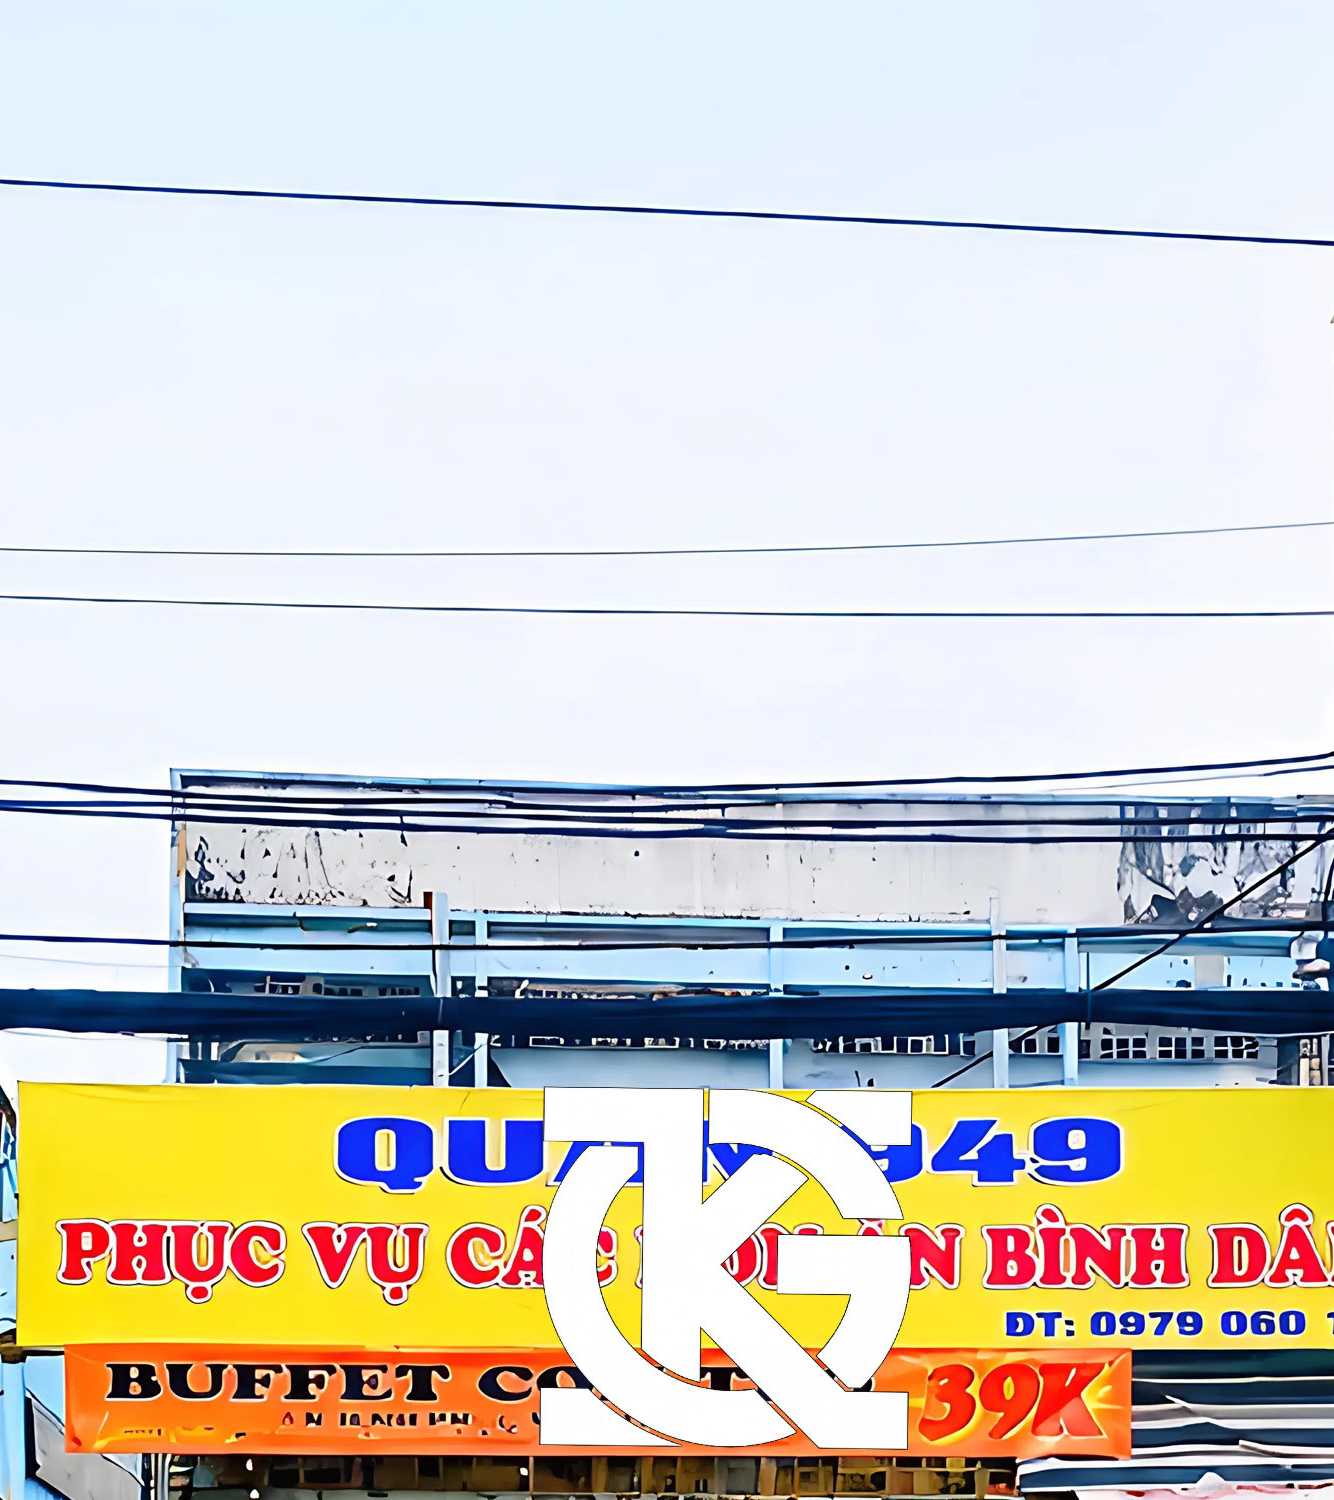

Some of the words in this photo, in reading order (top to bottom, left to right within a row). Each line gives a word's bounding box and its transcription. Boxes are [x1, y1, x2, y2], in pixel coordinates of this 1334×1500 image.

[56, 1218, 286, 1304] PHỤC
[302, 1221, 430, 1305] VỤ
[981, 1202, 1190, 1290] BÌNH
[1090, 1309, 1204, 1338] 0979
[1220, 1309, 1307, 1338] 060
[107, 1363, 452, 1402] BUFFET
[918, 1363, 1110, 1445] 39K
